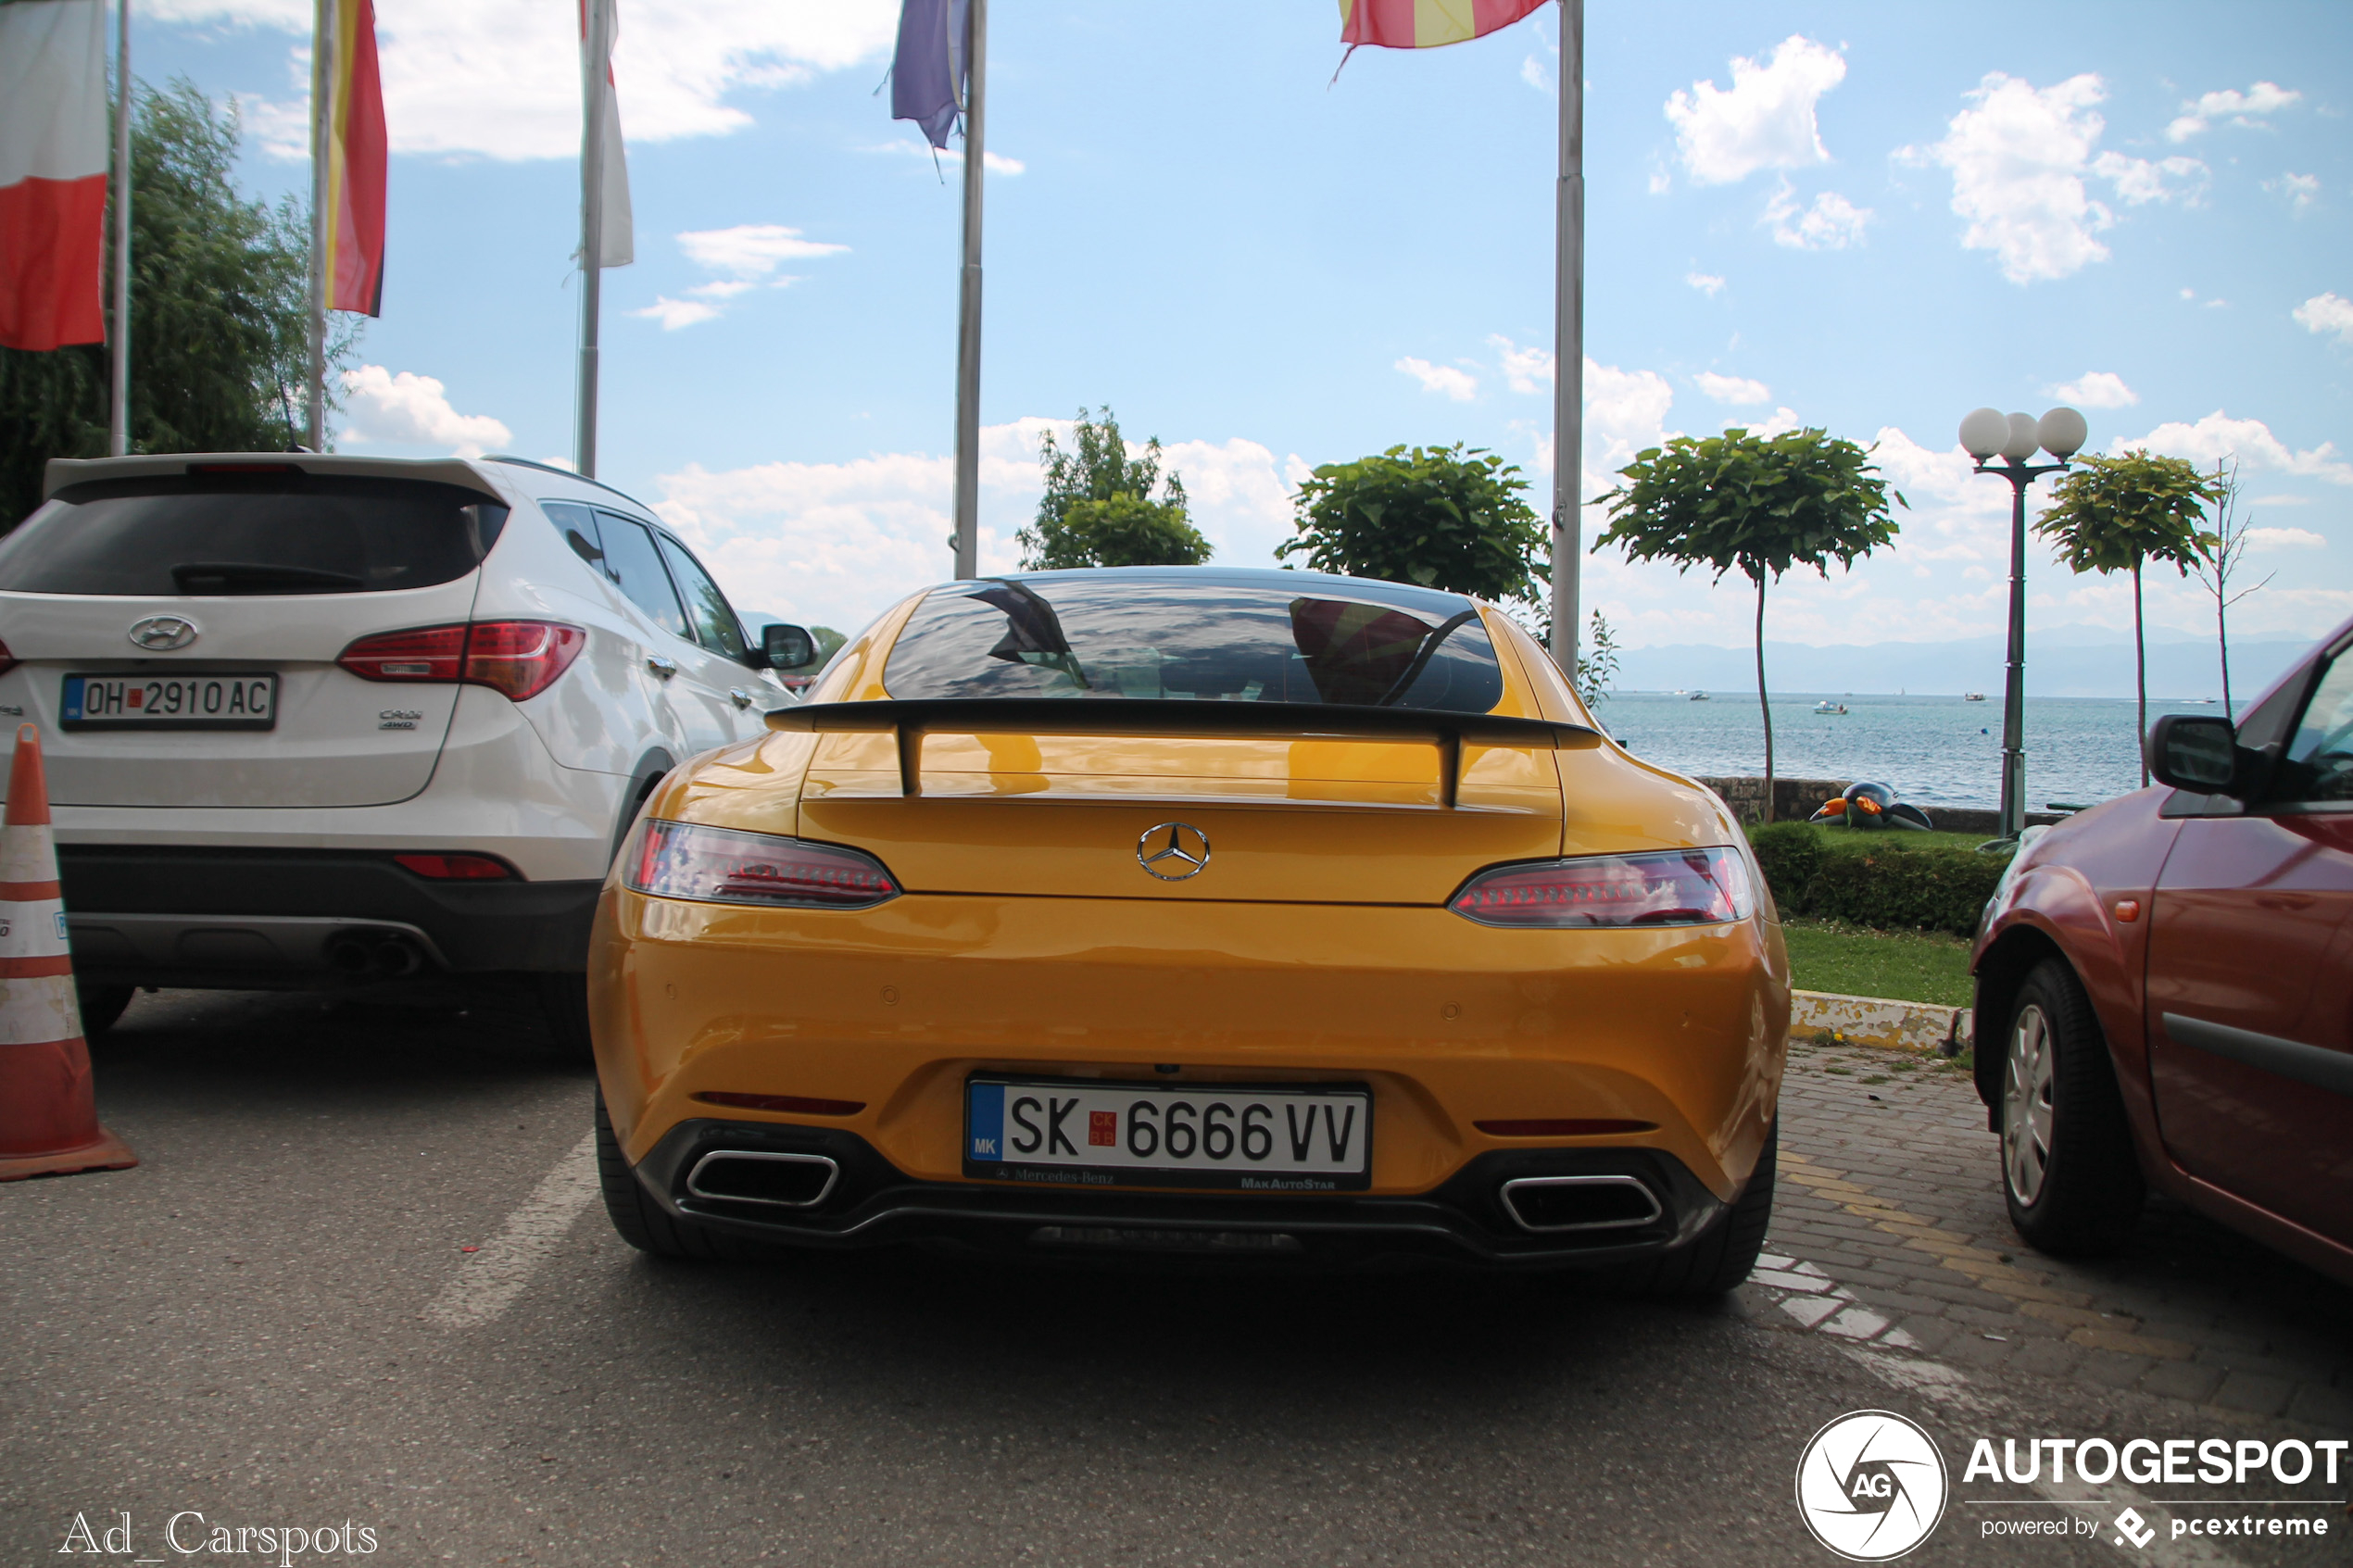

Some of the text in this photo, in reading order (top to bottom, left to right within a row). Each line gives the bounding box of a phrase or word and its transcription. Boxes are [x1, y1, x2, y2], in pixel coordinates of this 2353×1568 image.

[85, 682, 124, 714] OH
[144, 682, 222, 714] 2910
[228, 681, 268, 714] AC
[1011, 1096, 1356, 1163] SK 6666 VV
[975, 1138, 996, 1155] MK
[1015, 1168, 1114, 1185] Mercedes-Benz
